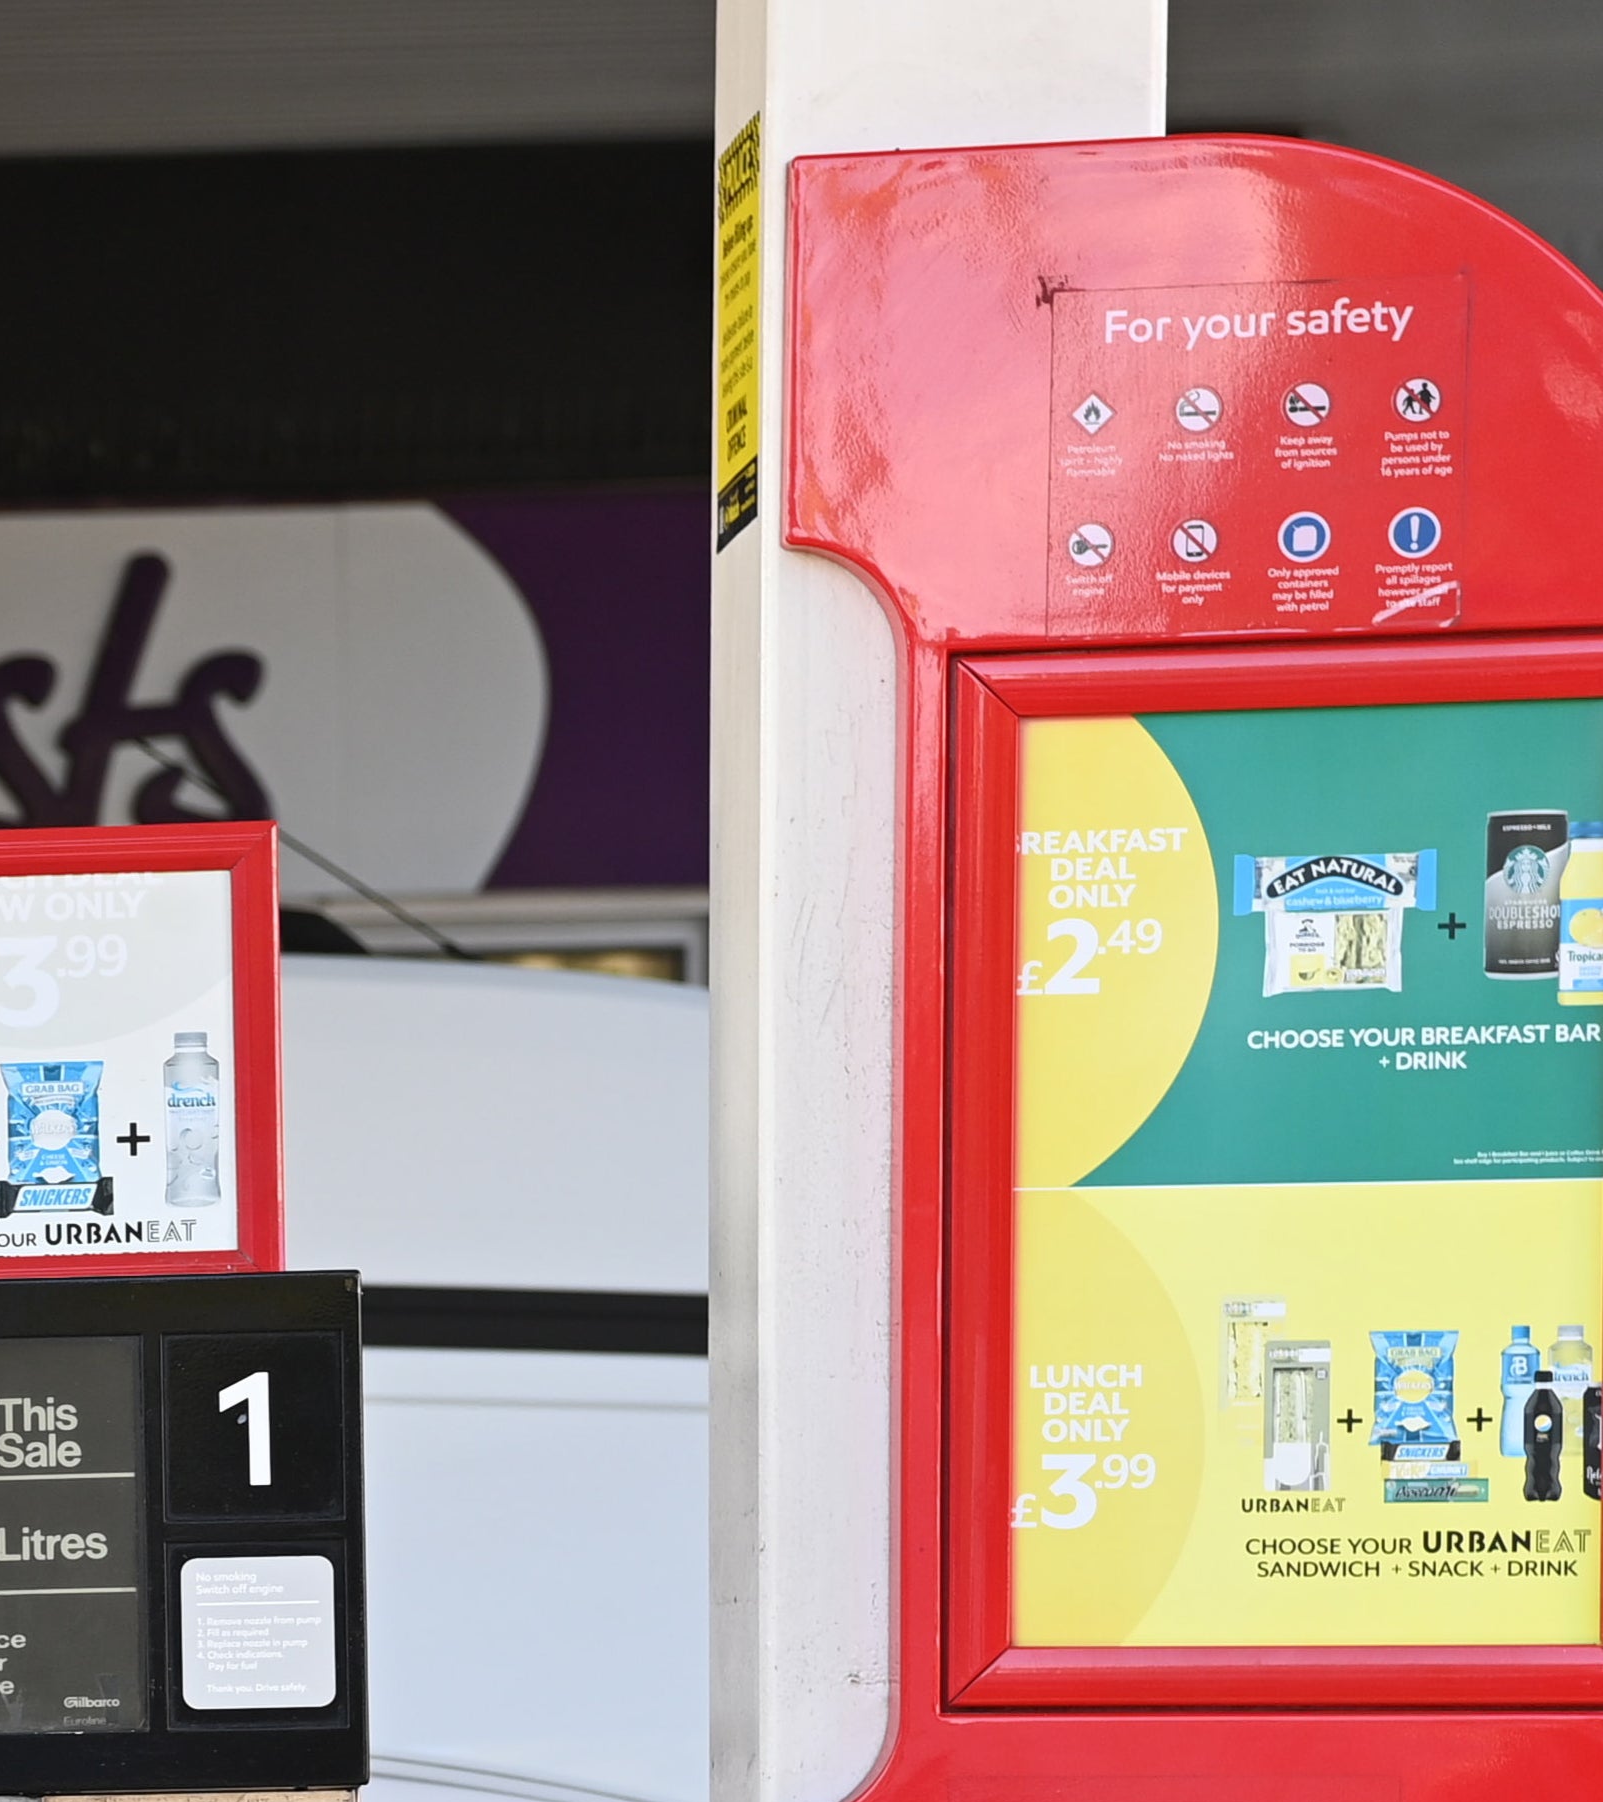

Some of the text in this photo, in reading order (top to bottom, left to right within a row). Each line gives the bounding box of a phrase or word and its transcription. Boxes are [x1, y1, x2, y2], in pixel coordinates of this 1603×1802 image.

[1104, 298, 1414, 351] For your safety
[1050, 856, 1136, 882] DEAL
[1047, 883, 1136, 909] ONLY
[1016, 917, 1163, 996] £2.49
[20, 1187, 93, 1209] SNICKERS
[45, 1218, 197, 1246] URBANEAT
[1028, 1364, 1143, 1388] LUNCH
[1043, 1392, 1129, 1416] DEAL
[217, 1369, 273, 1487] 1
[1041, 1418, 1130, 1443] ONLY
[1010, 1453, 1157, 1530] £3.99
[63, 1696, 121, 1708] Gilbarco
